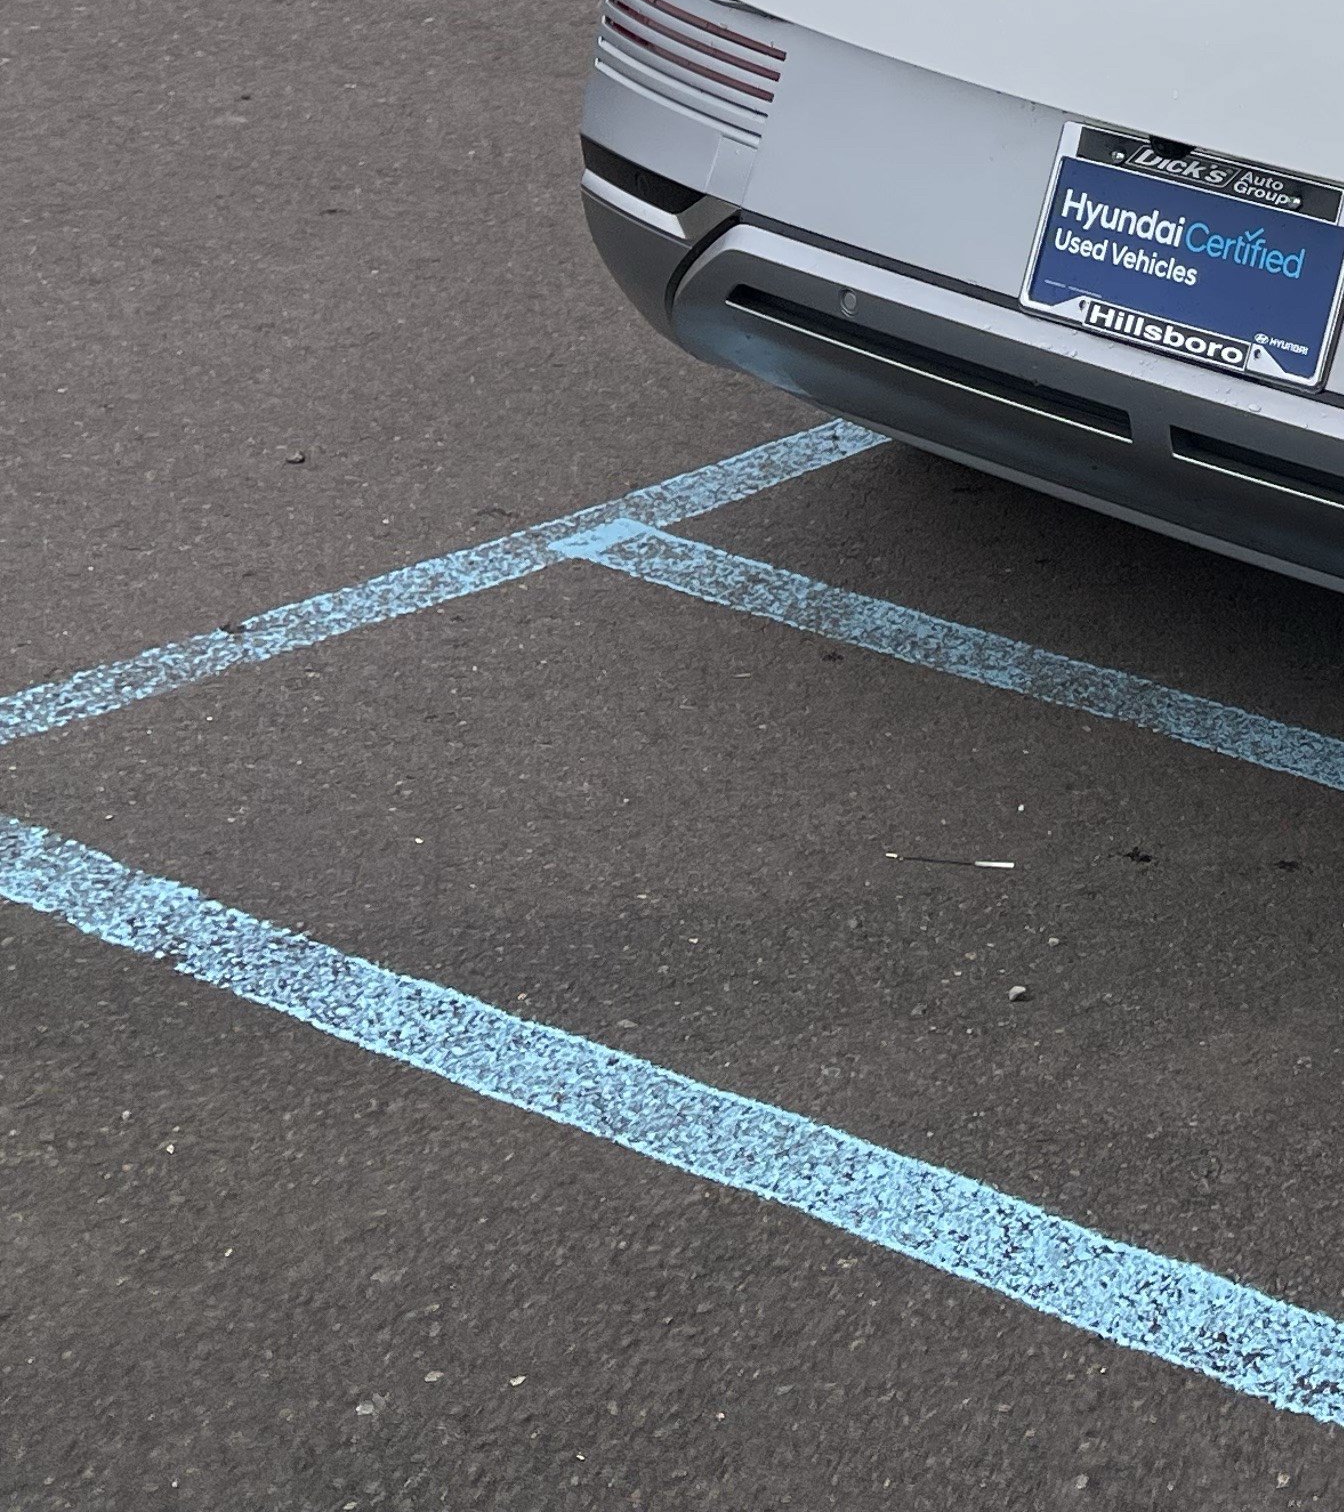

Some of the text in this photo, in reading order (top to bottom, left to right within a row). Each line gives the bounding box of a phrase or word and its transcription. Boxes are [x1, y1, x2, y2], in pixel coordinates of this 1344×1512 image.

[1233, 181, 1292, 206] Group
[1240, 171, 1284, 192] Auto
[1054, 227, 1199, 286] Used Vehicles
[1090, 304, 1244, 364] Hillsboro
[1268, 337, 1309, 356] HYUNDAI
